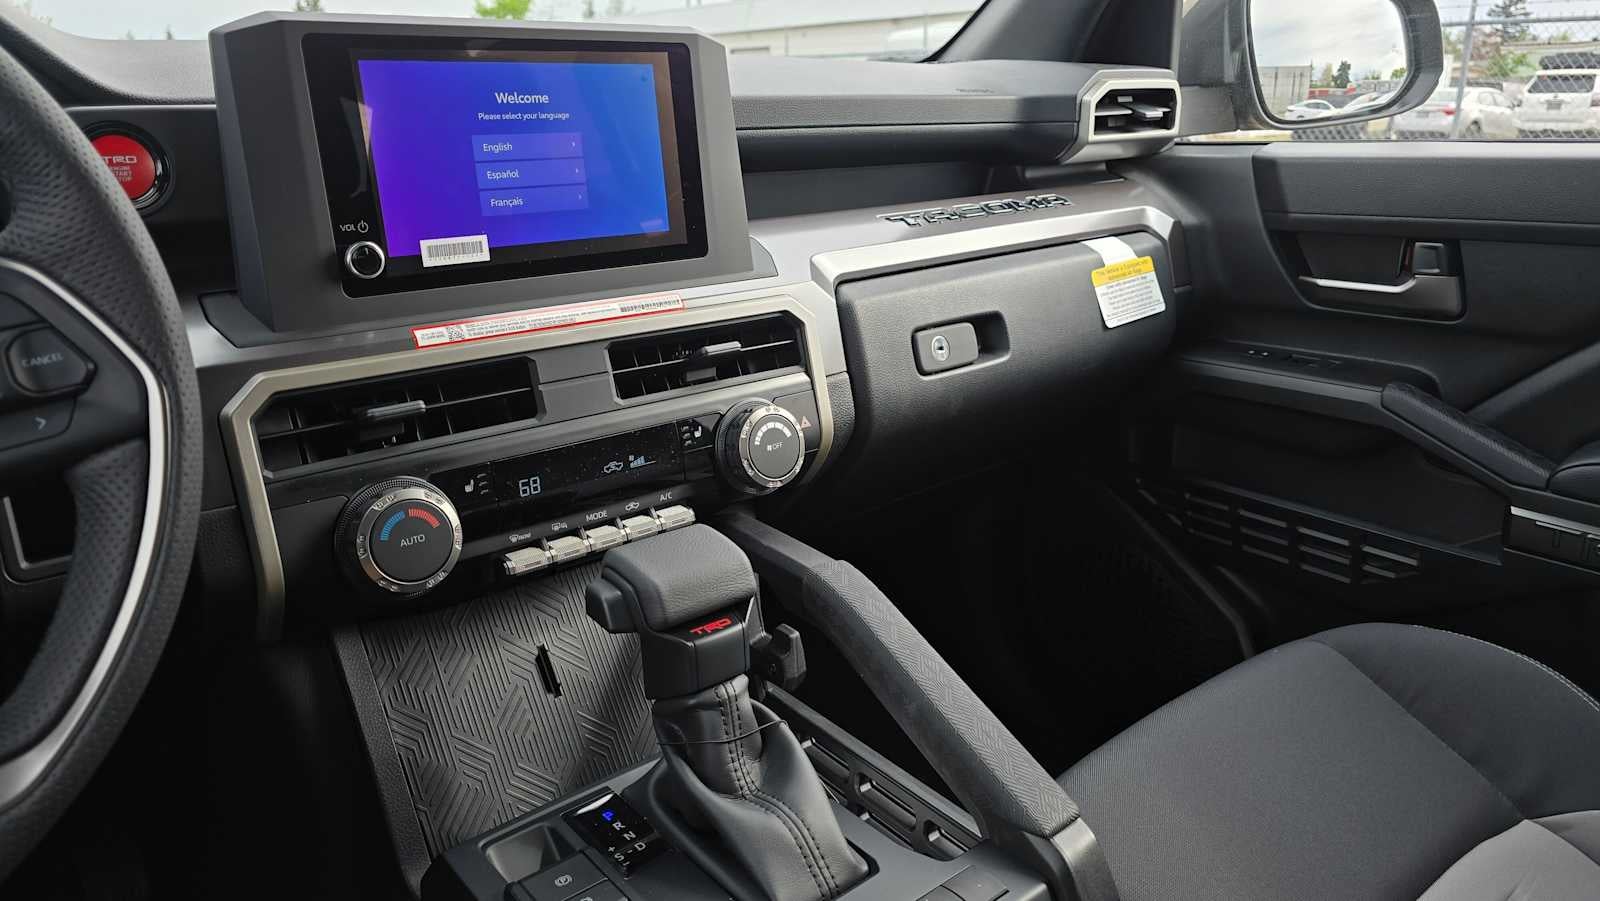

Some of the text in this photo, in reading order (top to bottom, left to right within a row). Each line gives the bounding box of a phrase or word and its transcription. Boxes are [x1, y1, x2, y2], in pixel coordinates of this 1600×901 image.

[495, 91, 549, 104] Welcome
[478, 111, 570, 121] Please select your language
[483, 142, 513, 154] English
[101, 155, 137, 164] TRD
[487, 168, 520, 180] Español
[491, 196, 524, 208] Français
[876, 193, 1072, 227] TACOMA
[340, 223, 356, 232] VOL
[22, 353, 64, 368] CANCEL
[772, 442, 784, 450] OFF
[519, 476, 541, 497] 68
[659, 491, 673, 501] A/C
[585, 510, 608, 522] MODE
[400, 534, 426, 548] AUTO
[689, 617, 733, 634] TRD
[602, 809, 615, 821] P
[612, 821, 626, 831] R
[623, 830, 637, 841] N
[634, 841, 647, 851] D
[614, 852, 625, 861] S
